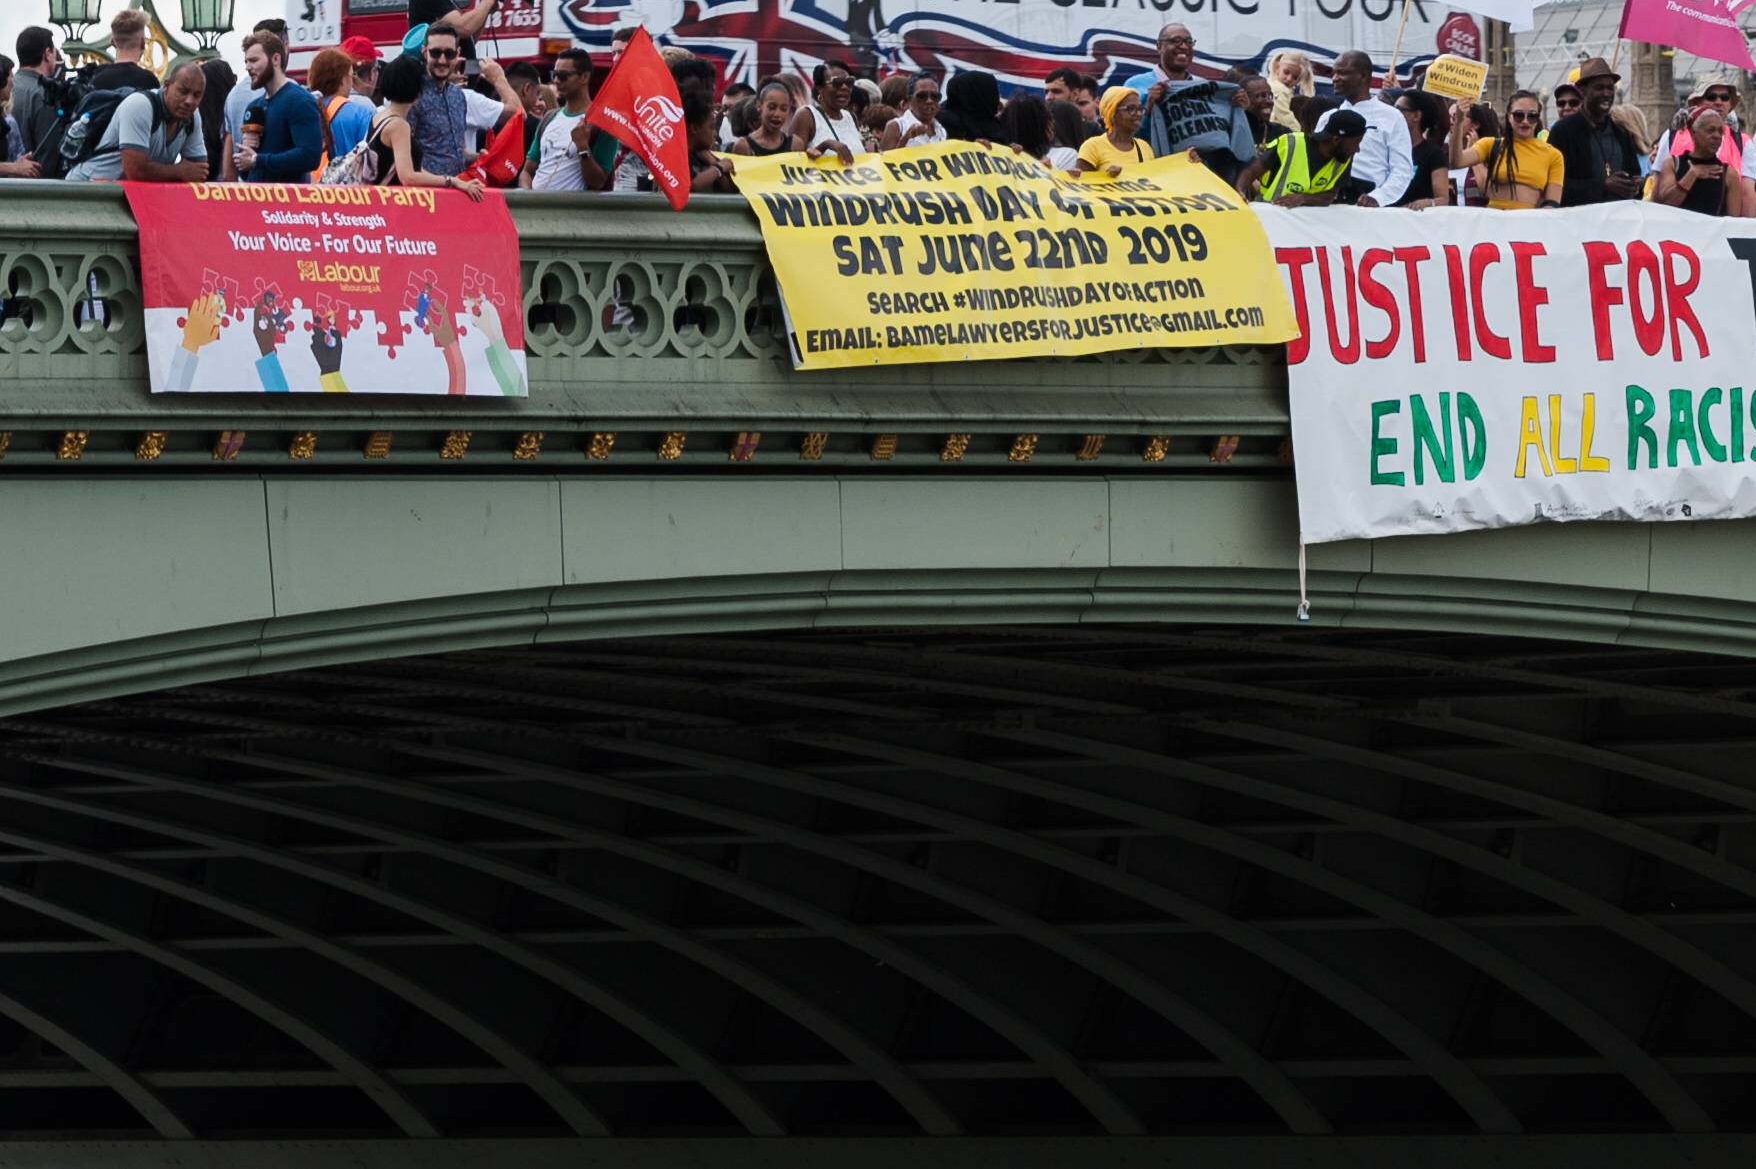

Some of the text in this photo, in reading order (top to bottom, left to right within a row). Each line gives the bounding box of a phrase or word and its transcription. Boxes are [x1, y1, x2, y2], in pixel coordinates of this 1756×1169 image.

[1666, 0, 1681, 12] The
[1429, 71, 1480, 91] Windrush
[969, 185, 1046, 222] DAY
[261, 210, 386, 230] Solidarity & Strength
[228, 231, 265, 251] Your
[267, 231, 311, 253] Voice
[324, 234, 350, 253] For
[352, 235, 382, 255] Our
[386, 236, 437, 256] Future
[1118, 222, 1209, 266] 2019
[316, 260, 380, 284] Labour
[1275, 241, 1556, 365] JUSTICE
[1582, 239, 1710, 362] FOR
[1370, 392, 1488, 486] END
[1515, 392, 1610, 479] ALL
